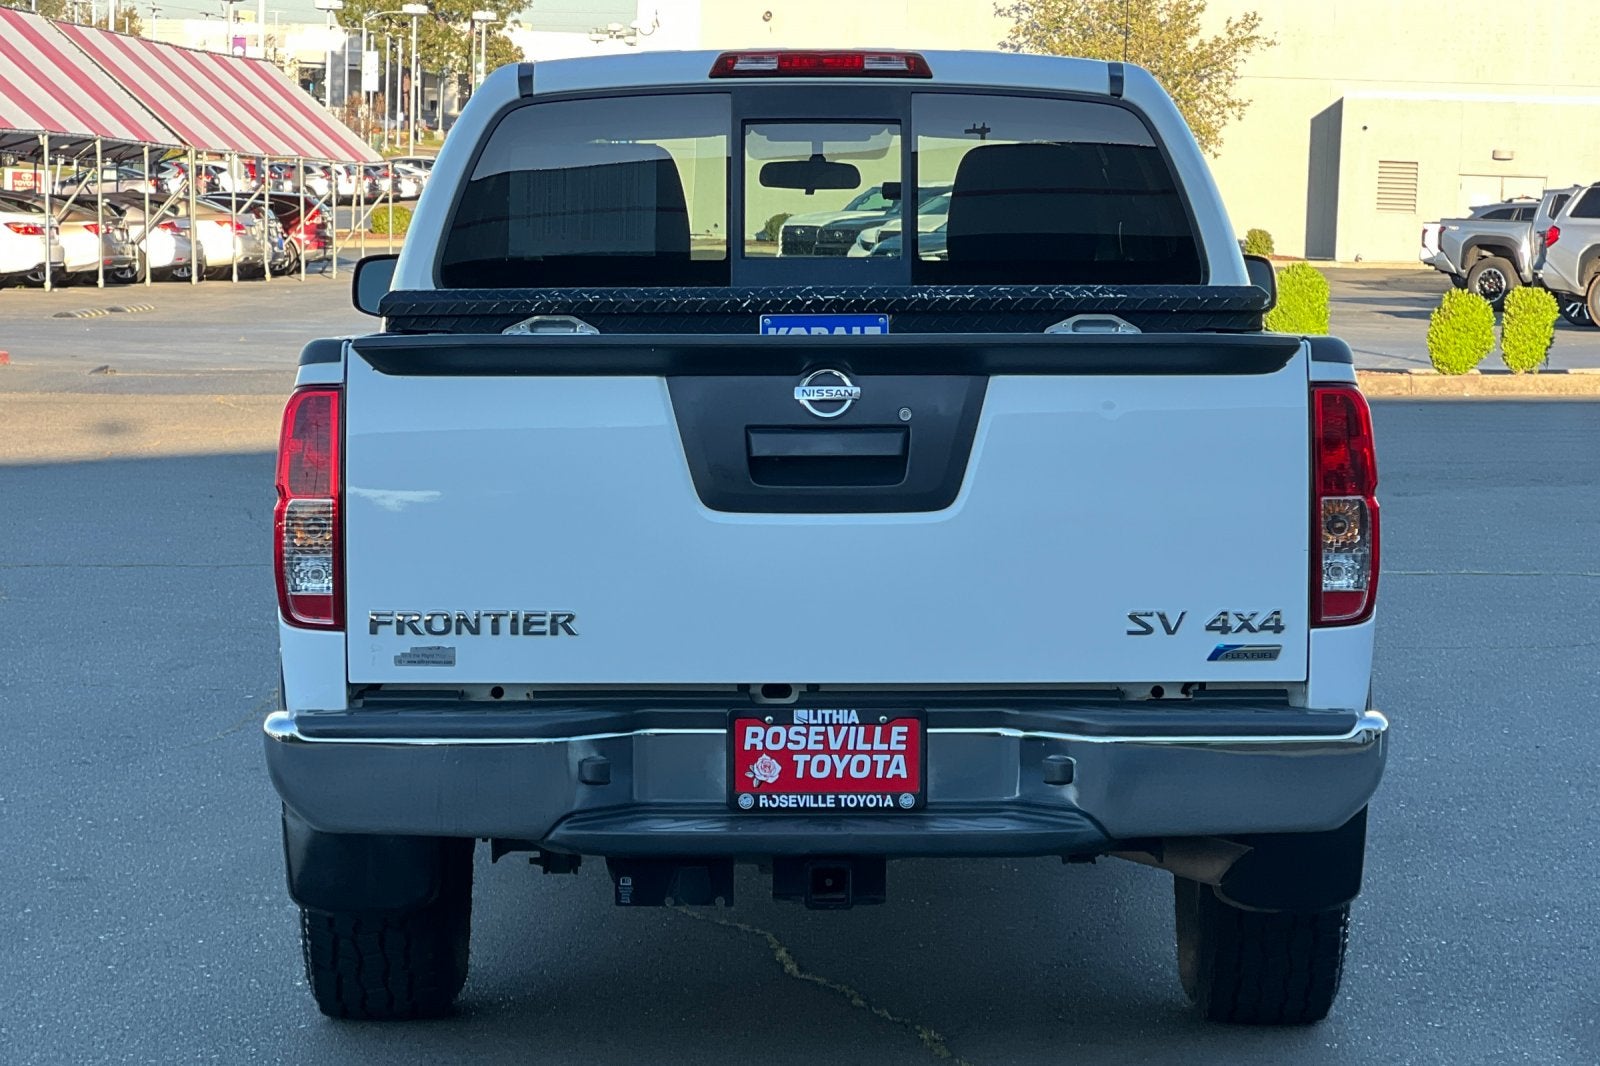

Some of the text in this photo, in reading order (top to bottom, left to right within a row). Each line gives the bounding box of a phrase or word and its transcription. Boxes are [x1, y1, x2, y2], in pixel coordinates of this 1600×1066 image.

[801, 388, 854, 398] NISSAN
[368, 610, 578, 636] FRONTIER
[1126, 611, 1188, 635] SV
[808, 709, 859, 724] LITHIA
[744, 726, 909, 751] ROSEVILLE
[792, 754, 908, 779] TOYOTA
[759, 795, 894, 808] ROSEVILLE TOYOTA
